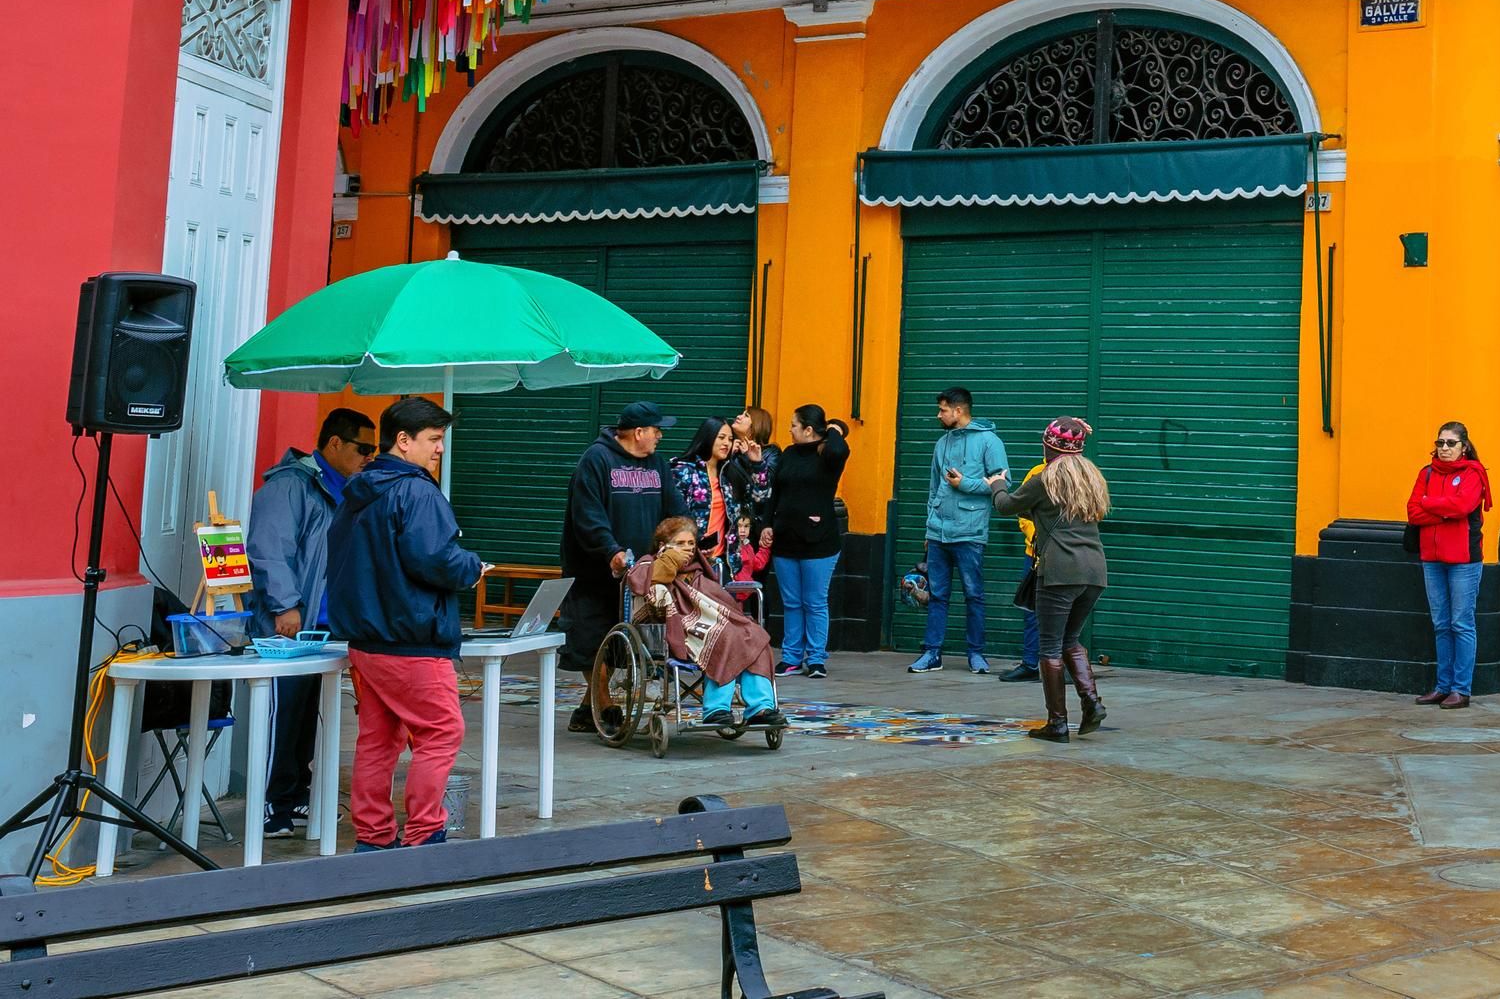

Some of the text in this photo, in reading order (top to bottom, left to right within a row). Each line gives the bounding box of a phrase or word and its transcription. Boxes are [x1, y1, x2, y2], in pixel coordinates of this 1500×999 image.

[1365, 2, 1416, 17] GALVEZ
[1383, 14, 1409, 23] CALLE
[1308, 196, 1328, 208] 37
